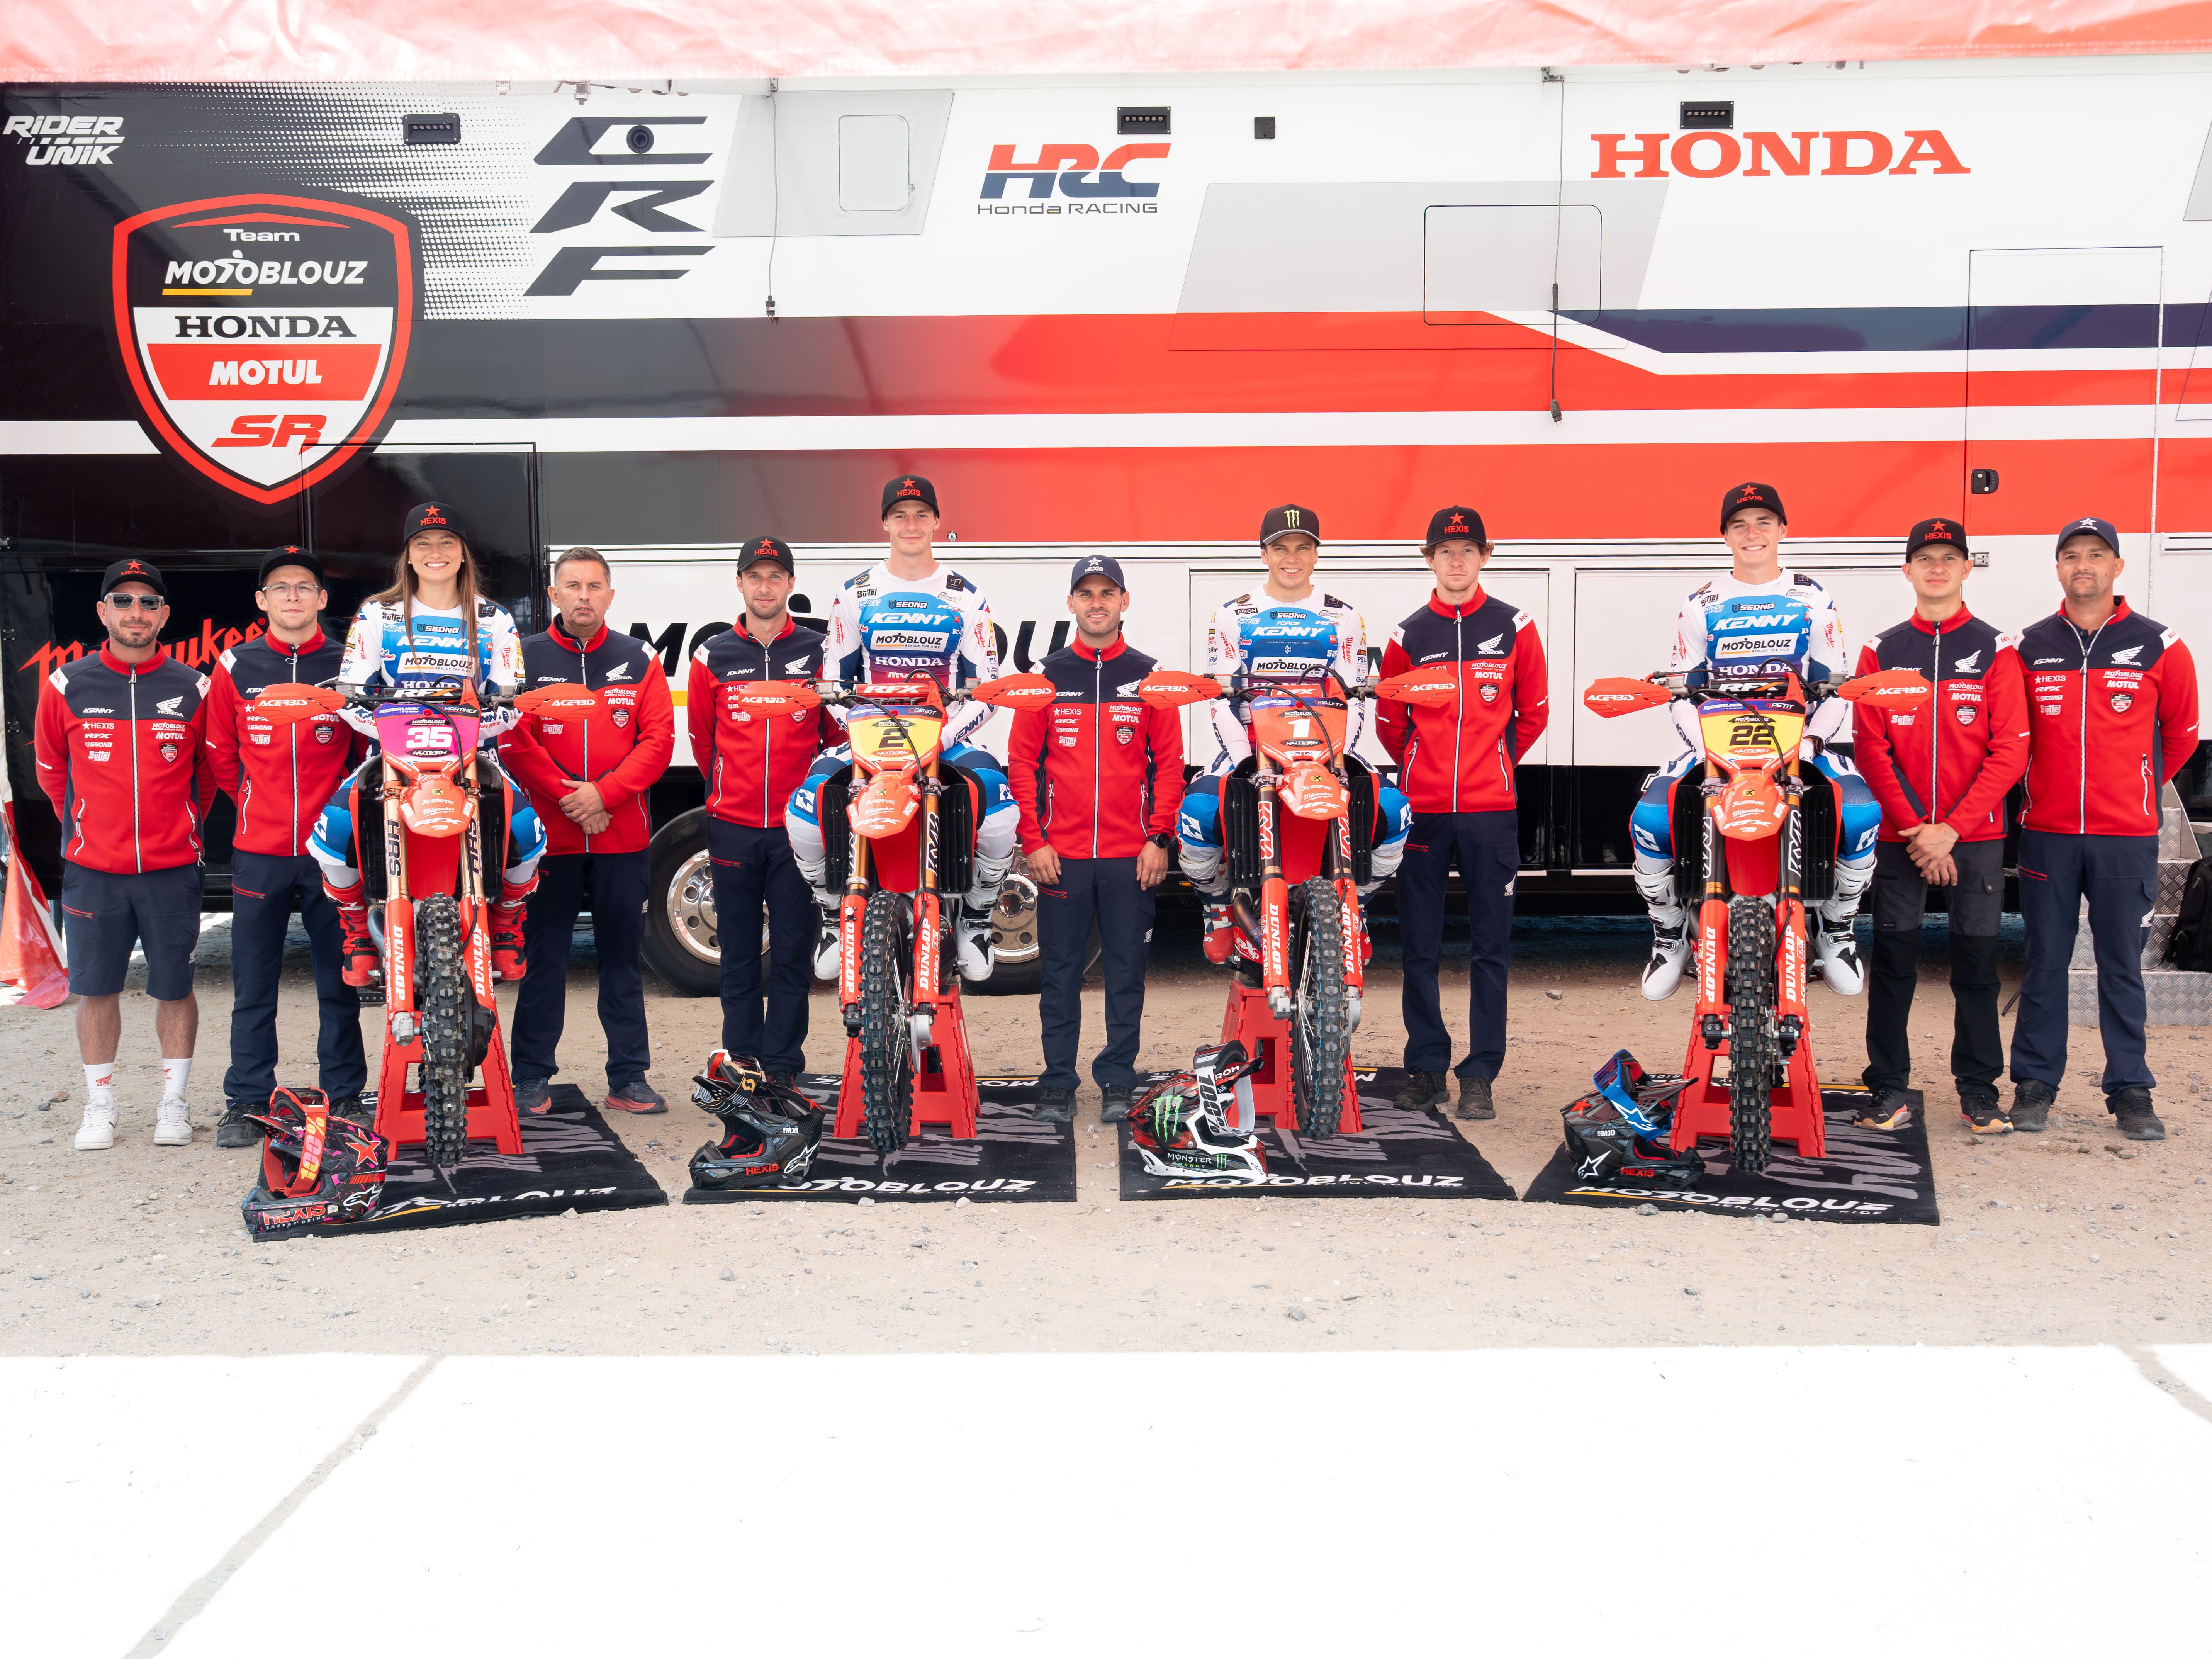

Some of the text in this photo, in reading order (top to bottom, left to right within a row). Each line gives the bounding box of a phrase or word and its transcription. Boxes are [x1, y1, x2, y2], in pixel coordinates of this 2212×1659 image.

[1591, 130, 1971, 179] HONDA
[981, 143, 1171, 199] HRC
[977, 203, 1157, 215] Honda RACING
[223, 229, 300, 242] Team
[165, 250, 368, 284] MOTOBLOUZ
[175, 316, 357, 337] HONDA
[209, 360, 322, 385] MOTUL
[211, 415, 327, 452] SR
[897, 489, 921, 498] HEXIS
[420, 517, 446, 526] HEXIS
[1445, 526, 1469, 534] HEXIS
[1925, 532, 1952, 540] HEXIS
[754, 548, 778, 557] HEXIS
[1739, 603, 1775, 611] SEDNA
[869, 613, 949, 625] KENNY
[1276, 611, 1307, 620] SEDNA
[1713, 614, 1799, 631] KENNY
[1251, 627, 1325, 637] KENNY
[876, 633, 942, 645] MOTOBLOUZ
[1721, 638, 1791, 652] MOTOBLOUZ
[404, 655, 473, 669] MOTOBLOUZ
[875, 657, 944, 666] HONDA
[1419, 652, 1449, 662] KENNY
[727, 668, 755, 676] KENNY
[1718, 663, 1794, 675] HONDA
[2104, 669, 2144, 679] MOTOBLOUZ
[1474, 671, 1503, 680] MOTUL
[1717, 681, 1784, 692] RFX
[1876, 686, 1928, 695] ACERBIS
[2106, 680, 2139, 689] MOTUL
[393, 689, 455, 698] RFX
[1951, 693, 1983, 701] MOTUL
[1110, 704, 1142, 712] MOTOBLOUZ
[1112, 714, 1139, 723] MOTUL
[1288, 719, 1310, 737] 1
[406, 727, 452, 749] 35
[878, 728, 908, 748] 2
[1729, 725, 1774, 746] 22
[1281, 790, 1292, 804] MOTUL
[422, 807, 455, 815] Milwaukee
[463, 802, 473, 818] MOTUL
[864, 807, 895, 815] Milwaukee
[902, 801, 917, 817] MOTUL
[1296, 802, 1343, 811] RFX
[1732, 808, 1765, 817] Milwaukee
[1773, 803, 1785, 818] MOTUL
[1713, 805, 1721, 821] MOTUL
[413, 818, 465, 827] RFX
[855, 817, 902, 827] RFX
[1723, 820, 1775, 830] RFX
[387, 820, 402, 878] HRS
[1270, 903, 1282, 975] DUNLOP
[1342, 903, 1354, 974] DUNLOP
[473, 922, 485, 997] DUNLOP
[846, 921, 855, 993] DUNLOP
[919, 917, 934, 991] DUNLOP
[393, 925, 406, 1000] DUNLOP
[1706, 925, 1716, 1003] DUNLOP
[1786, 925, 1798, 1003] DUNLOP
[1198, 1074, 1227, 1134] 100%
[301, 1116, 325, 1180] 100%
[1167, 1152, 1212, 1164] MONSTER
[745, 1163, 779, 1175] HEXIS
[1251, 1161, 1264, 1176] AIROH
[1621, 1167, 1654, 1177] HEXIS
[778, 1177, 1037, 1192] OTOBLOUZ
[1570, 1186, 1894, 1210] MOTOBLOUZ
[263, 1201, 326, 1226] HEXIS
[302, 1215, 326, 1224] DRINK
